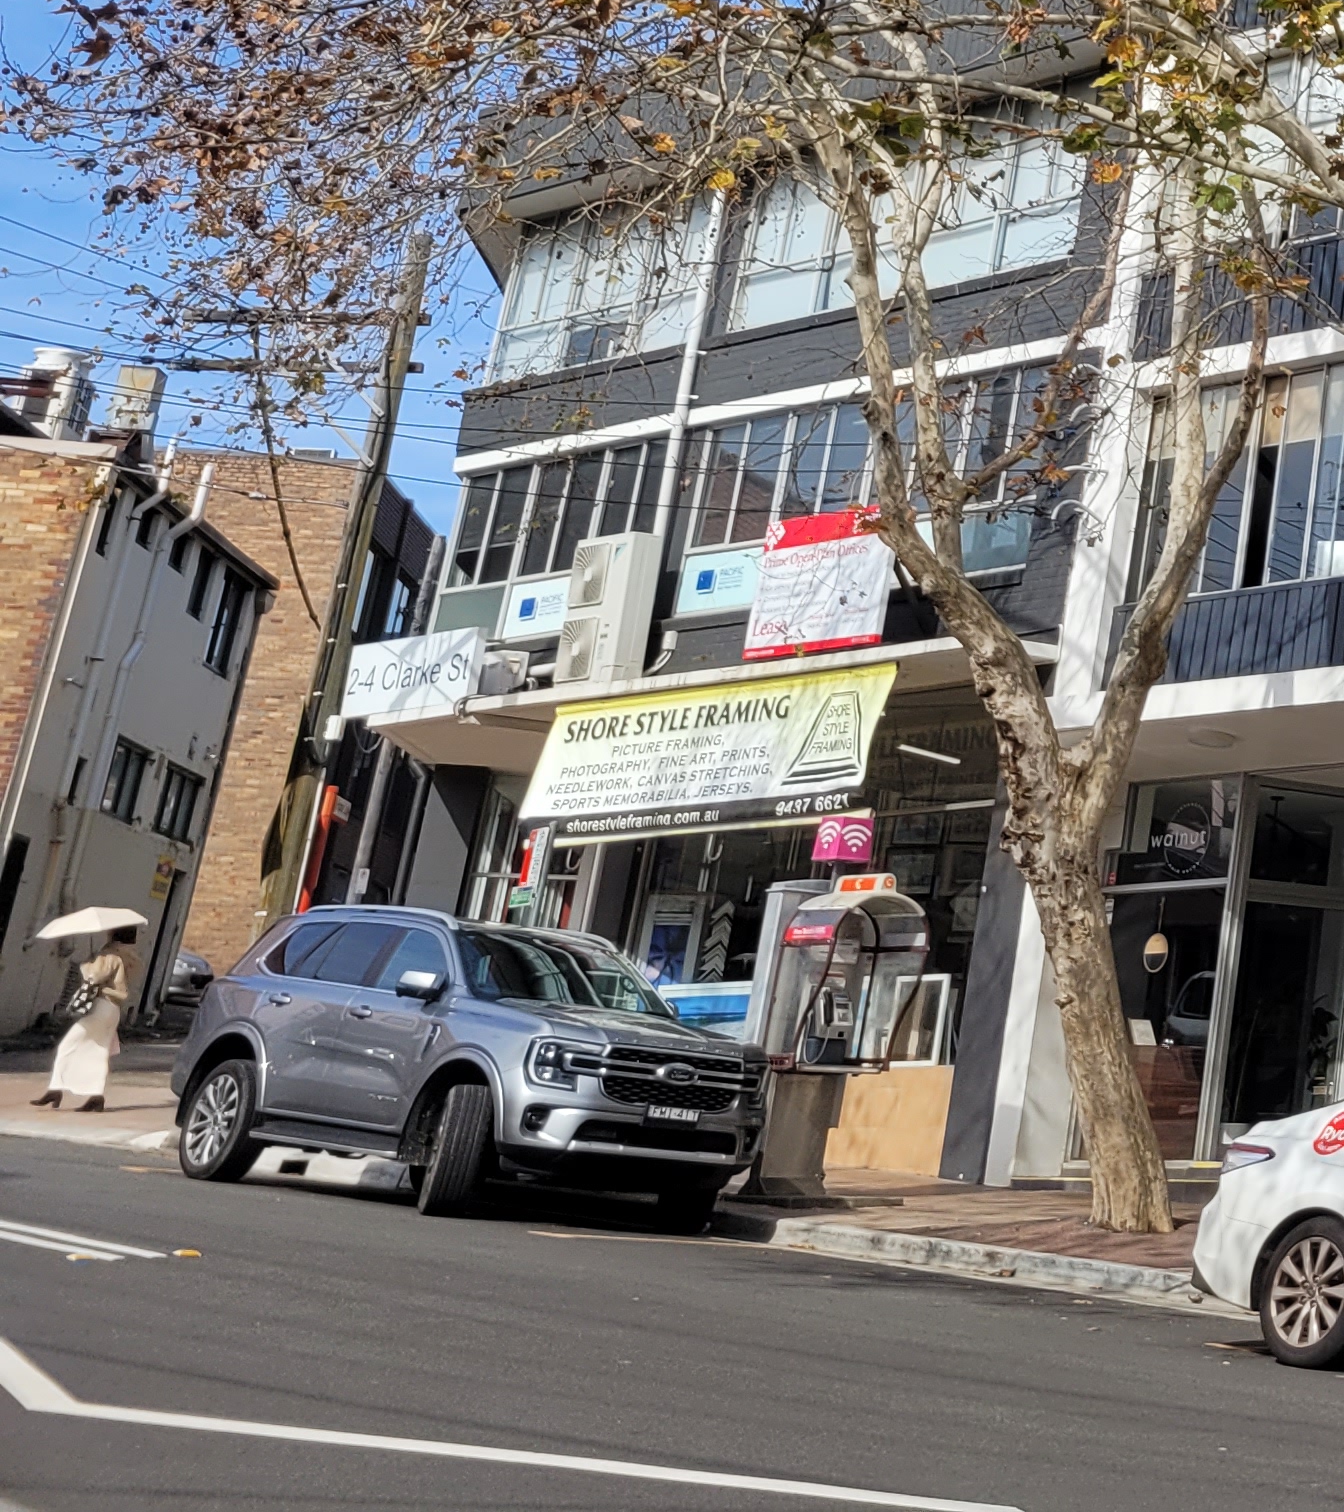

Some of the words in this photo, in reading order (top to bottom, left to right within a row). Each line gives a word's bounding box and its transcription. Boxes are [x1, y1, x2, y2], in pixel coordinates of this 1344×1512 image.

[752, 619, 788, 637] Lease
[347, 665, 376, 696] 2-4
[382, 657, 441, 691] Clarke
[448, 653, 470, 682] St
[564, 714, 631, 744] SHORE
[633, 707, 692, 735] STYLE
[694, 695, 791, 729] FRAMING
[827, 703, 851, 718] SHORE
[823, 722, 850, 736] STYLE
[611, 741, 663, 758] PICTURE
[665, 734, 725, 752] FRAMING,
[809, 738, 852, 755] FRAMING
[559, 759, 651, 780] PHOTOGRAPHY,
[658, 755, 688, 769] FINE
[689, 751, 716, 766] ART,
[720, 746, 770, 763] PRINTS,
[546, 777, 633, 795] NEEDLEWORK,
[637, 770, 686, 787] CANVAS
[689, 763, 773, 783] STRETCHING,
[551, 797, 601, 810] SPORTS
[603, 788, 690, 807] MEMORABILIA,
[693, 782, 753, 798] JERSEYS.
[566, 808, 720, 833] shorestyleframing.com.au
[1151, 830, 1207, 848] walnut
